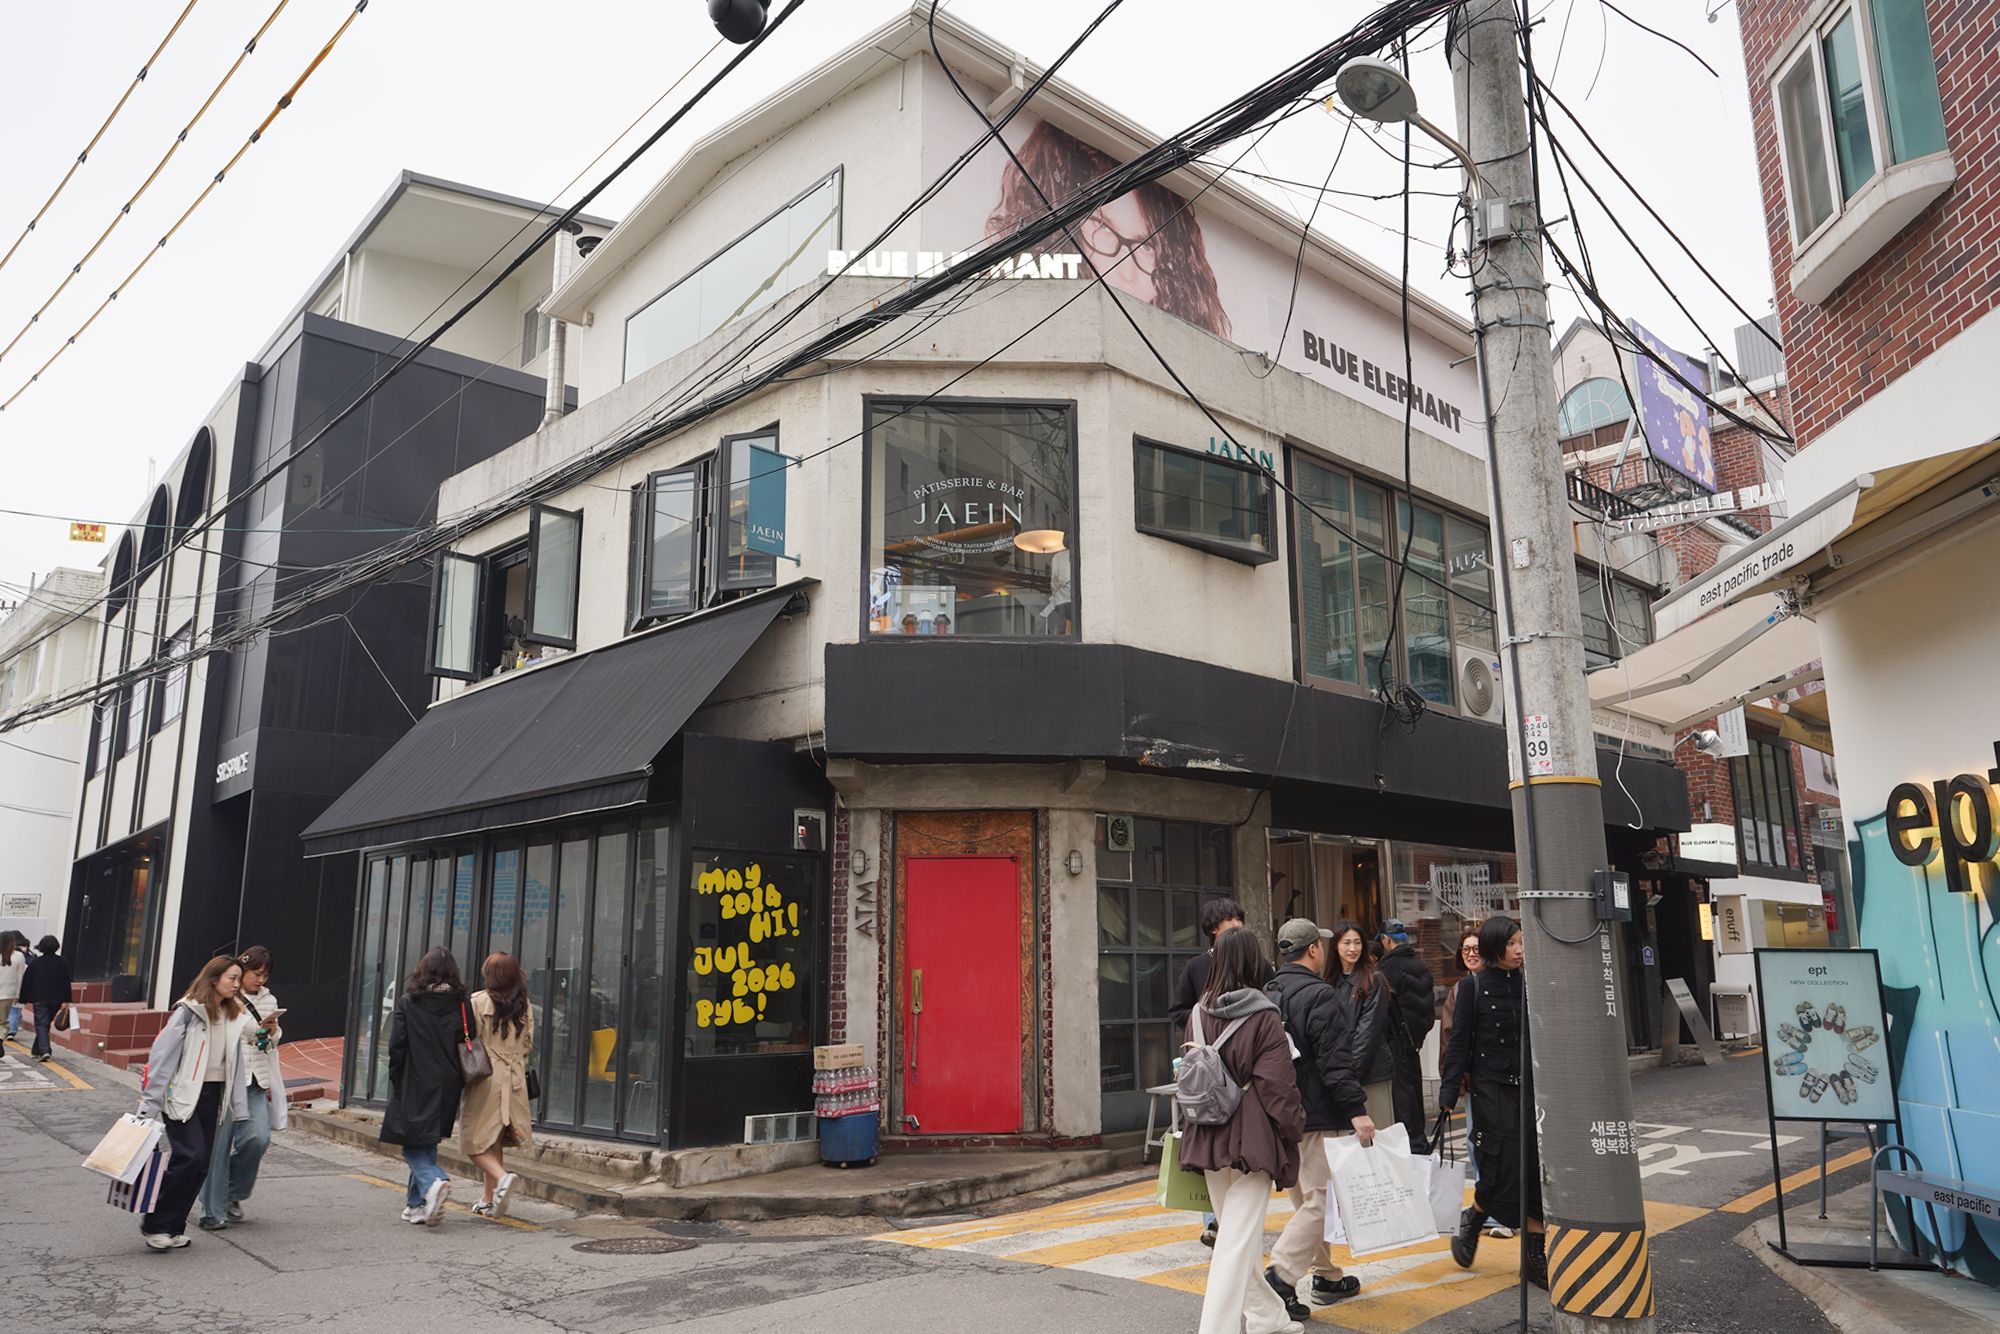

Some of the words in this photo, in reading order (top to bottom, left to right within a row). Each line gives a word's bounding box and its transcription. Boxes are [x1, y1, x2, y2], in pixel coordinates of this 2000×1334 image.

[827, 249, 908, 277] BLUE
[1303, 328, 1360, 384] BLUE
[1362, 358, 1461, 434] ELEPHANT
[913, 477, 983, 499] PÂTISSERIE
[986, 479, 997, 490] &
[1000, 482, 1025, 500] BAR
[914, 502, 1022, 525] JAEIN
[751, 523, 784, 541] JAEIN
[1700, 582, 1721, 607] east
[1724, 562, 1760, 598] pacific
[1762, 542, 1794, 571] trade
[1528, 740, 1548, 758] 39
[698, 863, 761, 895] MAY
[720, 883, 782, 920] 2014
[855, 880, 874, 938] ATM
[749, 902, 800, 944] HI!
[1725, 907, 1740, 942] enuff
[693, 941, 756, 976] JUL
[1808, 965, 1828, 977] ept
[731, 962, 796, 997] 2026
[696, 992, 767, 1028] BYE!
[1590, 1120, 1627, 1137] 새로운
[1590, 1137, 1629, 1155] 행복한
[1934, 1190, 1955, 1205] east
[1957, 1197, 1991, 1214] pacific
